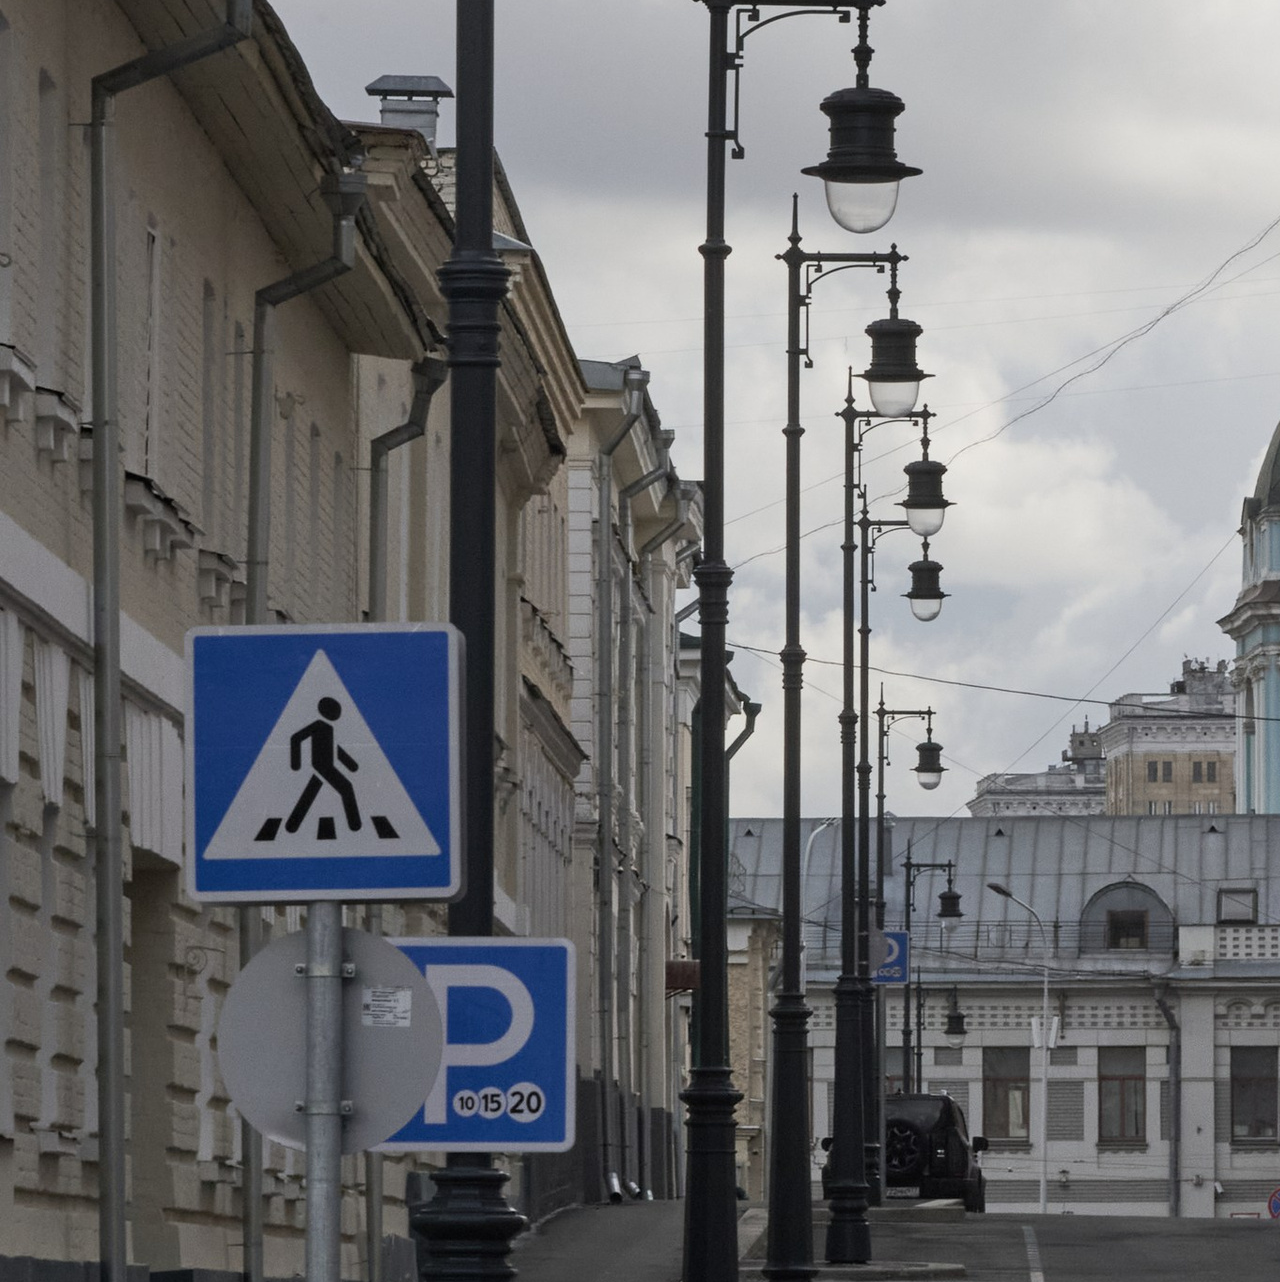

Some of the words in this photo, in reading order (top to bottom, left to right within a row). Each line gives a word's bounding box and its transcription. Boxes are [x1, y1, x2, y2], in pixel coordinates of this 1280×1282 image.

[424, 964, 535, 1124] P
[458, 1095, 475, 1111] 10
[481, 1093, 502, 1113] 15
[509, 1090, 542, 1114] 20
